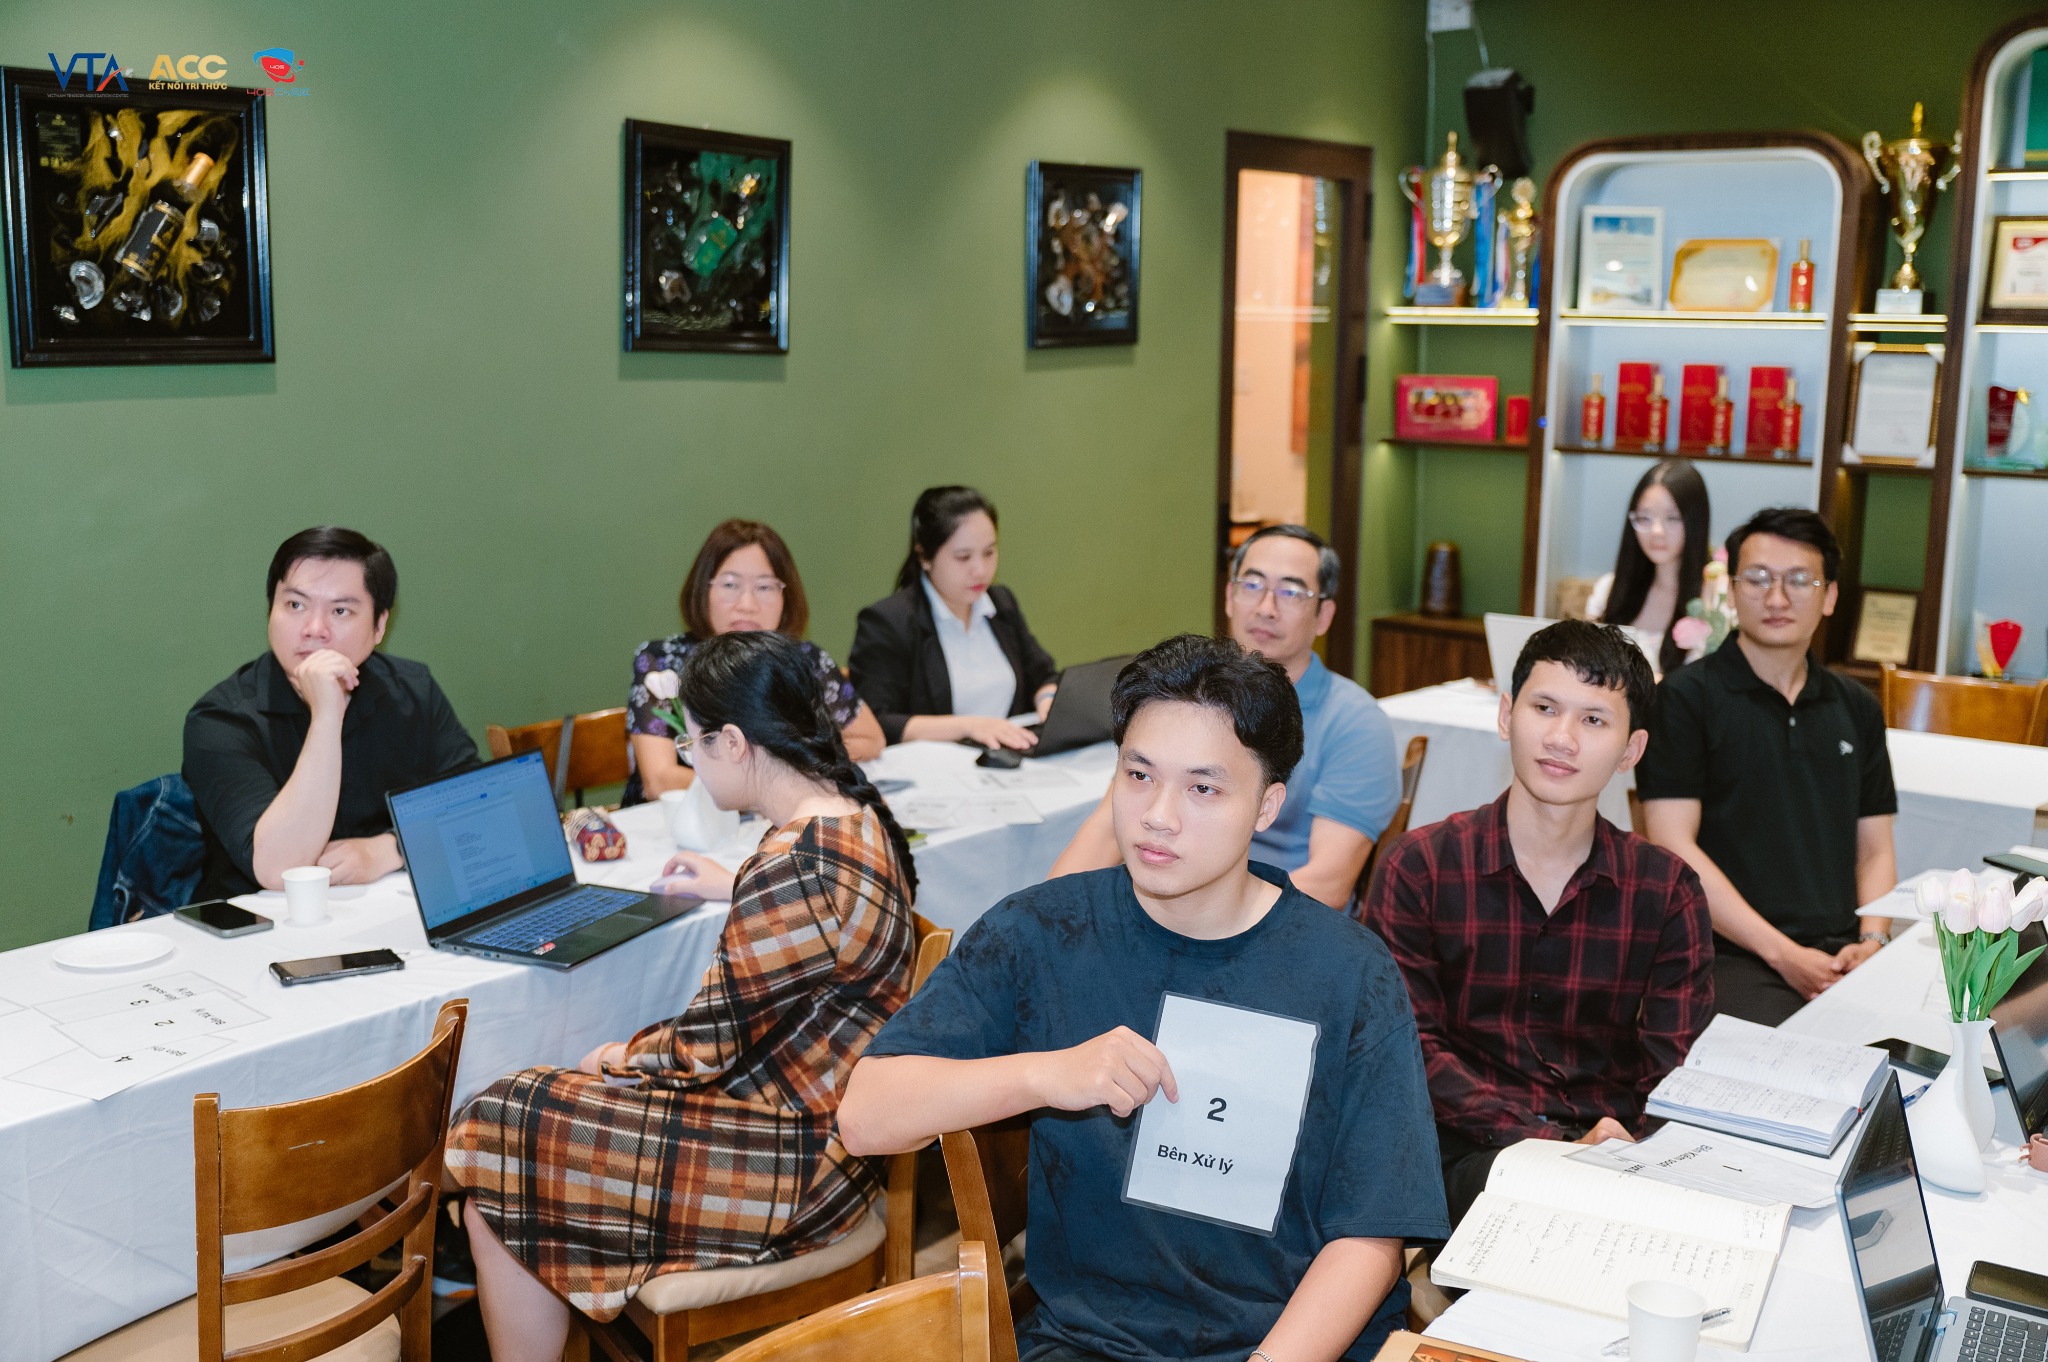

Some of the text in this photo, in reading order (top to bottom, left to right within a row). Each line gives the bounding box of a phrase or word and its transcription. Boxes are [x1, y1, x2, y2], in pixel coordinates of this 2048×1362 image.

[1206, 1097, 1228, 1123] 2
[1157, 1144, 1234, 1175] Bên Xử lý
